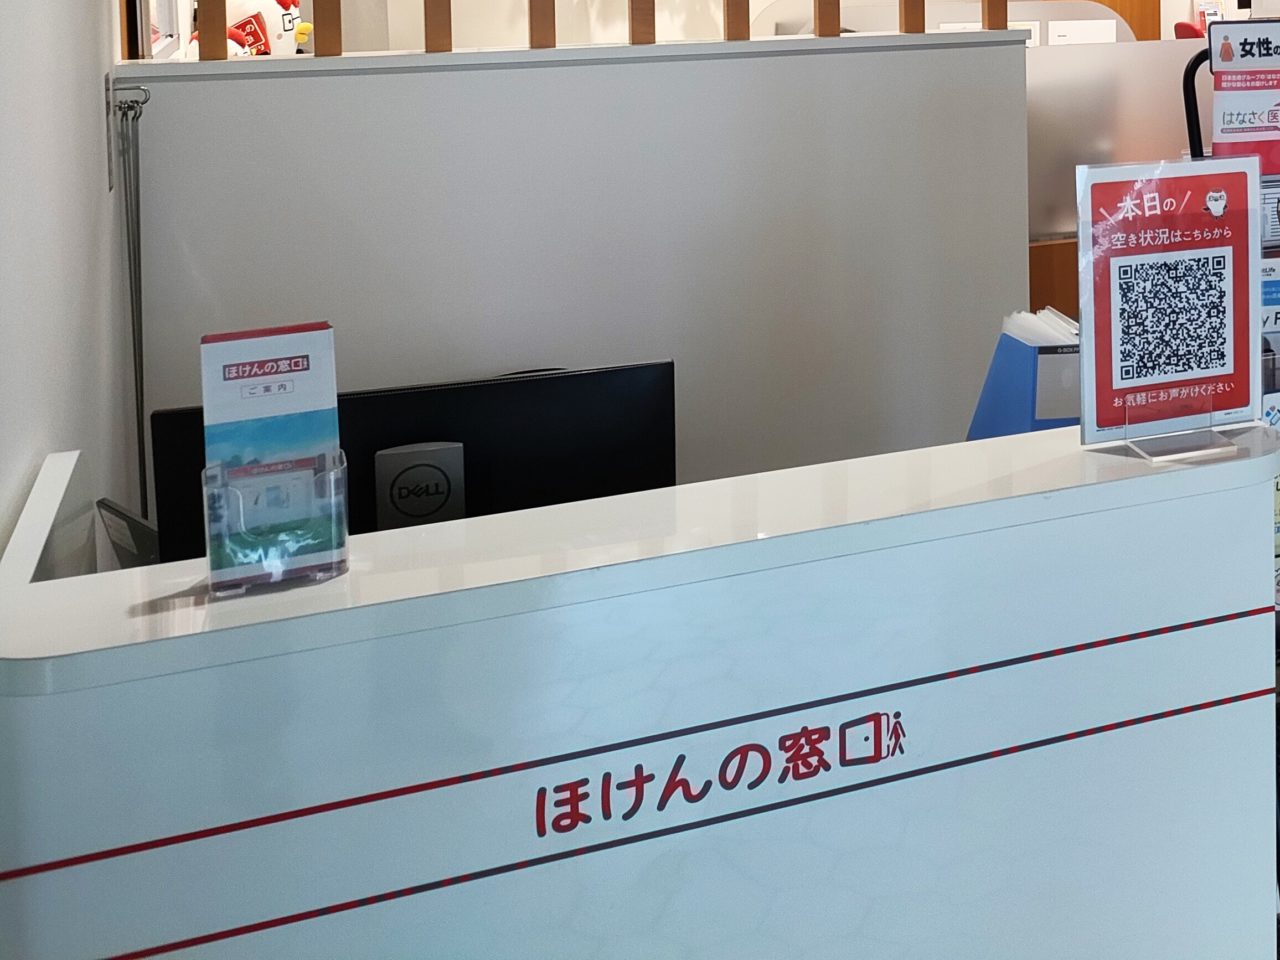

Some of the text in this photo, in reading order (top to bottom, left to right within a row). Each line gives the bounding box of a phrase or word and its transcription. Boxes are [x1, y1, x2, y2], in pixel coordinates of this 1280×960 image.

[1117, 192, 1176, 221] 本日の
[1111, 226, 1233, 249] 空き状況はこちらから
[225, 357, 304, 378] ほけんの窓口
[1113, 382, 1235, 407] お気軽にお声がけください
[398, 484, 444, 500] DELL
[536, 712, 892, 838] ほけんの窓口
